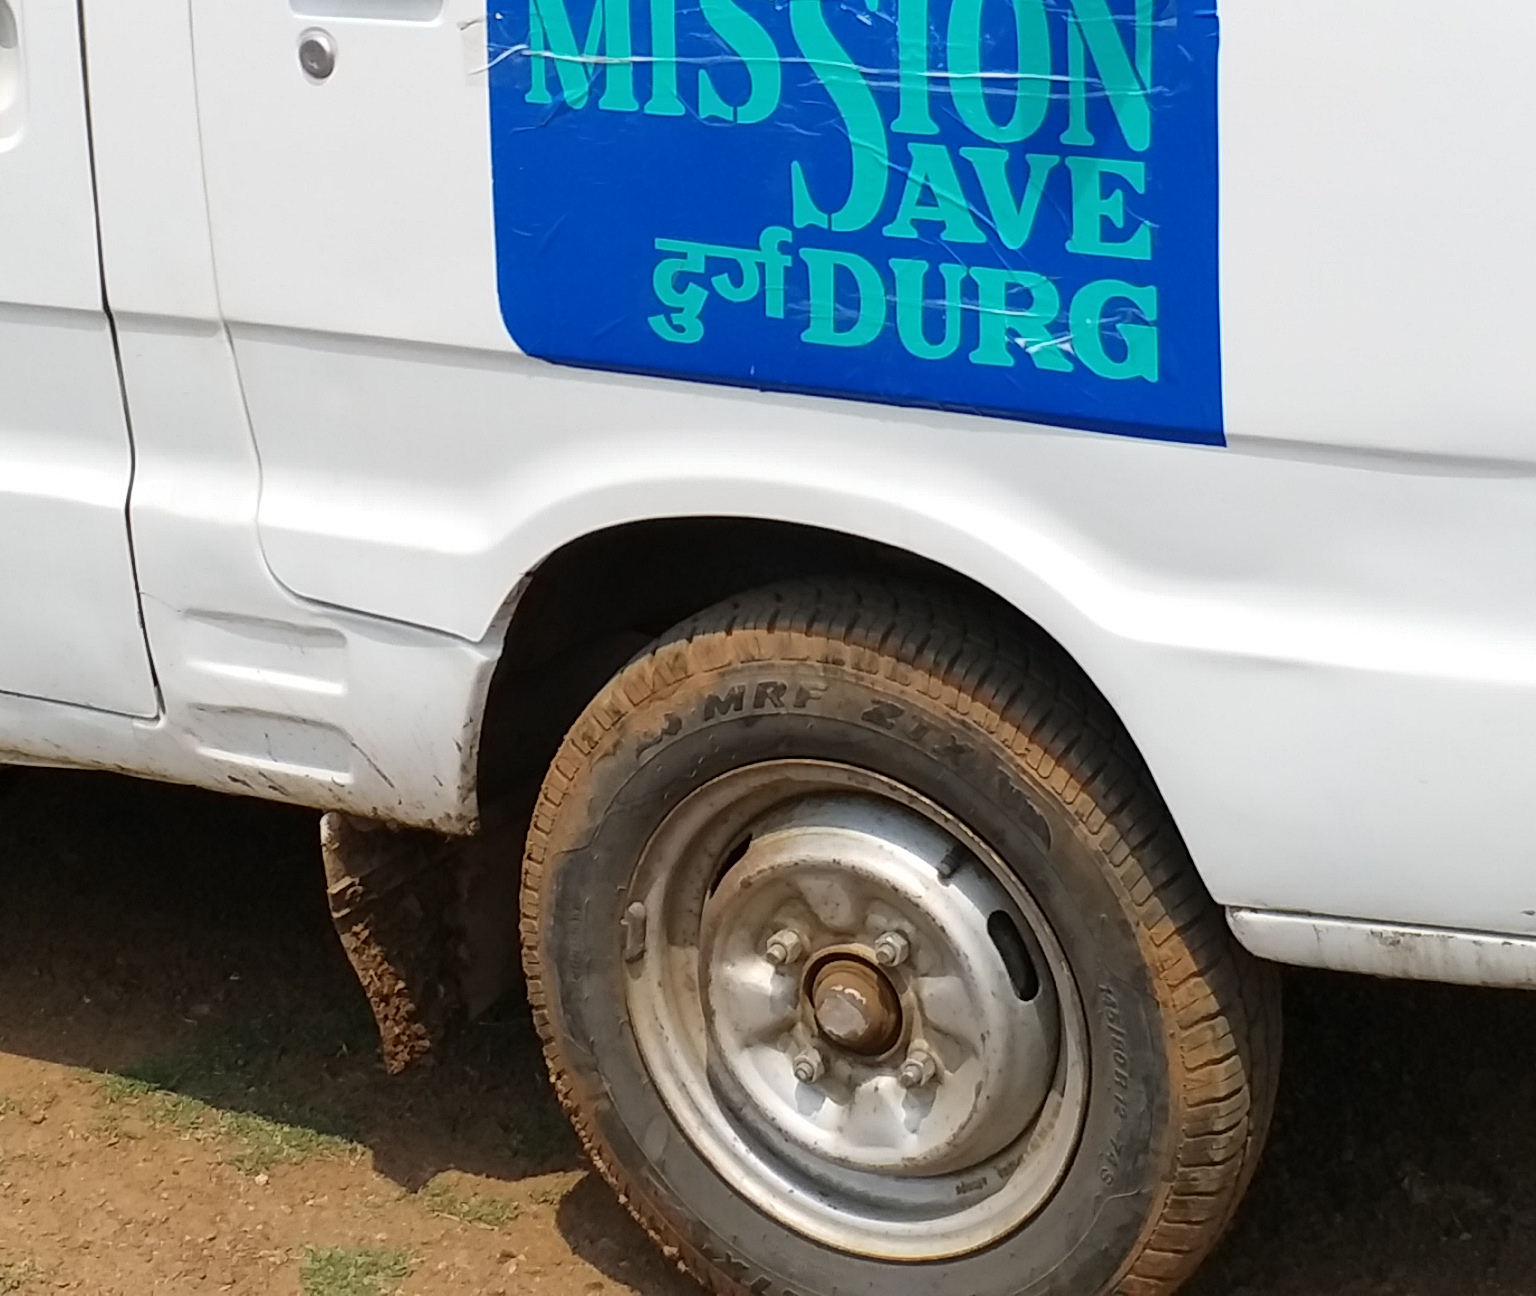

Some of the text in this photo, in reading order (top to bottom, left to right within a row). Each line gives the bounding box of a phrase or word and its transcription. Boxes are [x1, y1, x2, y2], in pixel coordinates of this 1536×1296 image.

[649, 226, 1160, 383] दुर्ग DURG
[703, 681, 829, 722] MRF
